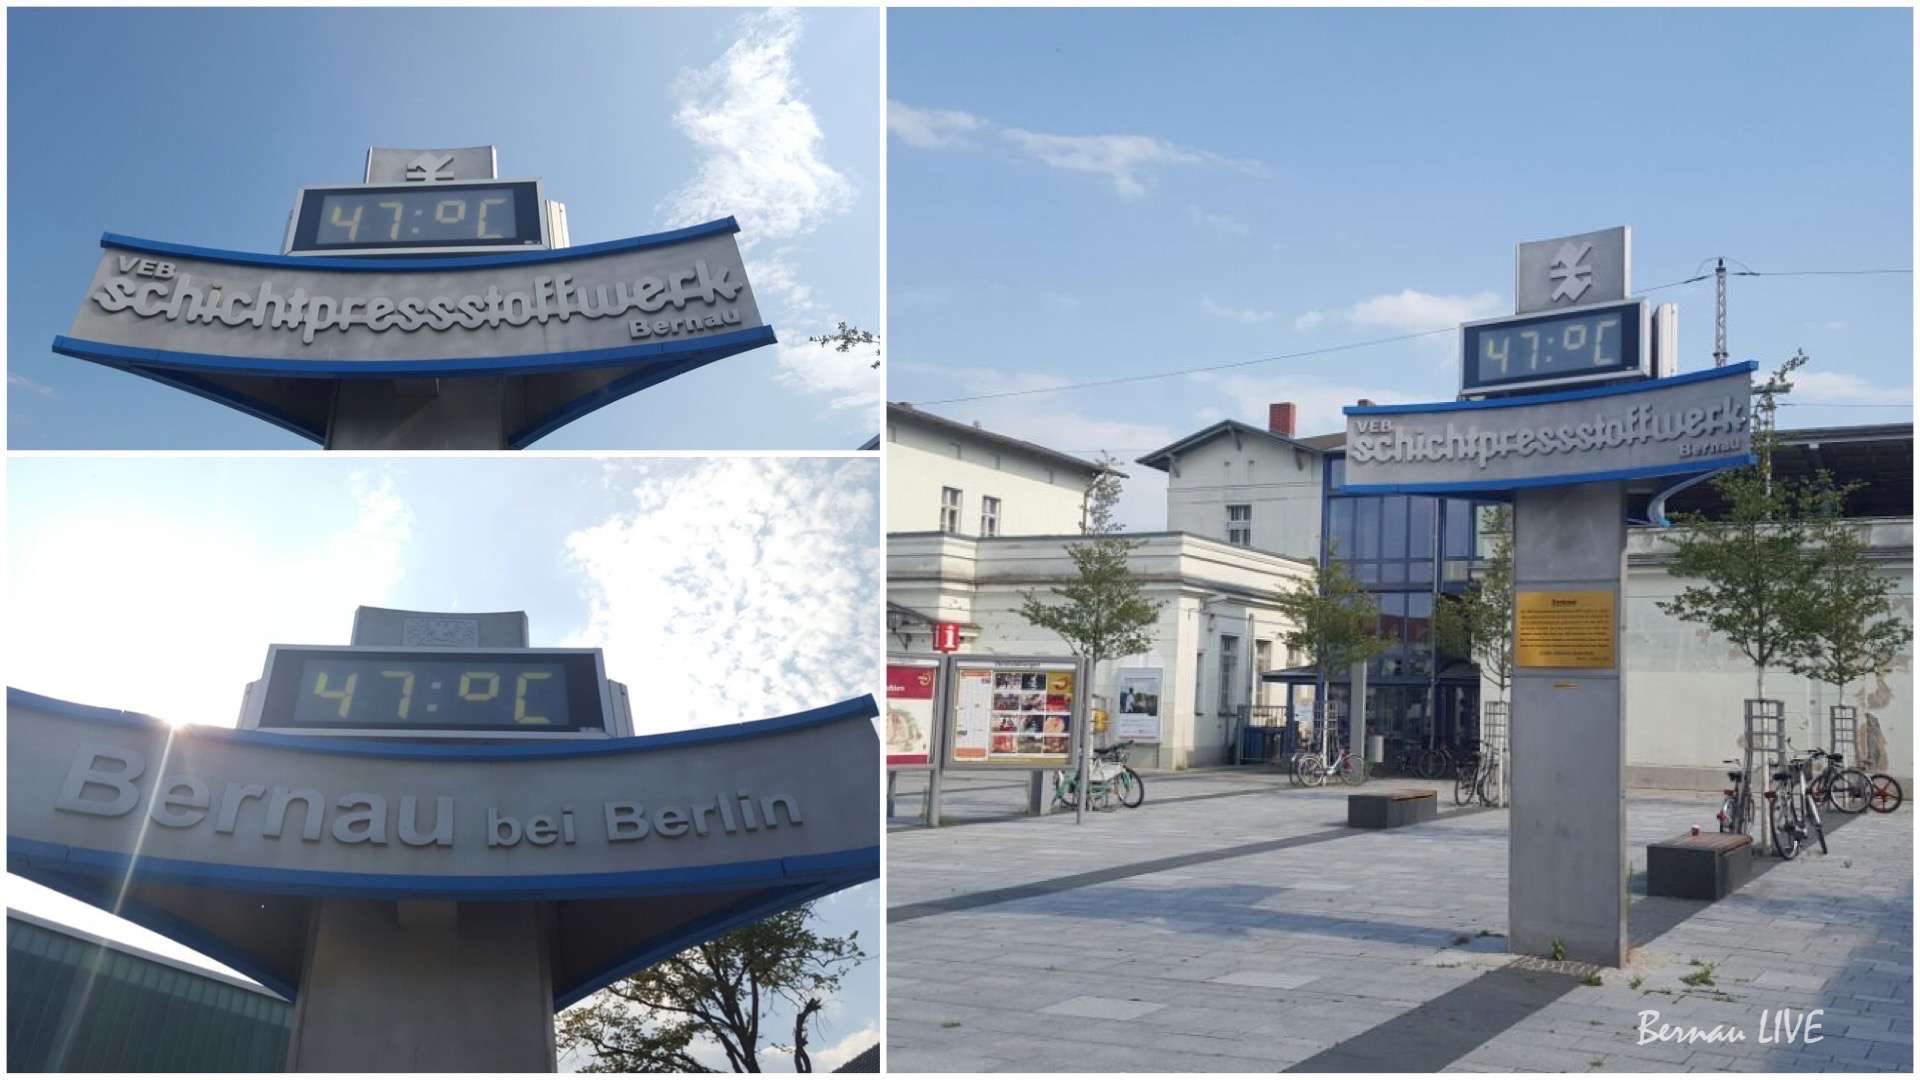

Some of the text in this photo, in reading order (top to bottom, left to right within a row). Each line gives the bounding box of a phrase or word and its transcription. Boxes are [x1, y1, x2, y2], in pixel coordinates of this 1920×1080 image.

[116, 255, 175, 279] VEB
[93, 259, 741, 344] schichtpressstoffwerk
[629, 305, 742, 340] Bernau
[1351, 398, 1747, 467] schichtpressstoffwerk
[1356, 419, 1394, 433] VEB
[1678, 438, 1742, 459] Bernau
[54, 742, 803, 849] Bernau bei Berlin
